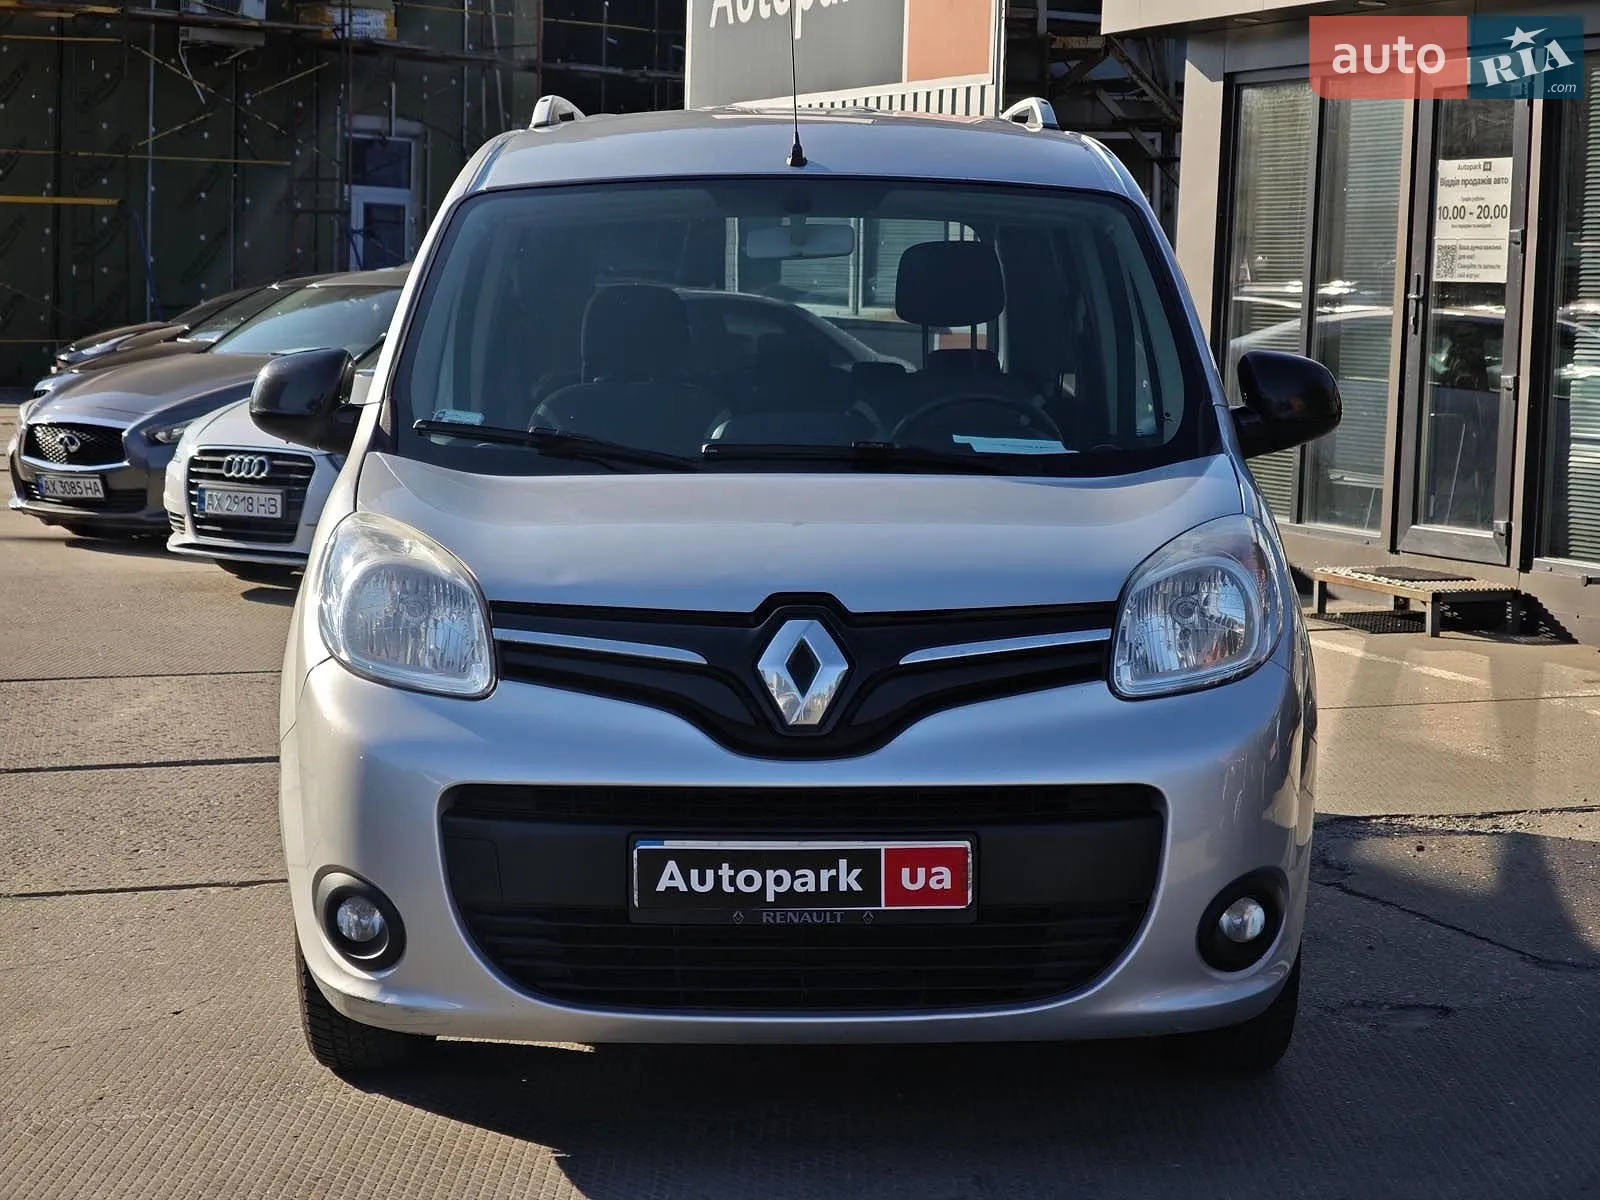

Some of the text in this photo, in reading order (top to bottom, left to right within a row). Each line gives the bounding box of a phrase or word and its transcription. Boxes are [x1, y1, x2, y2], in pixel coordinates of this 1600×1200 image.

[1457, 162, 1482, 172] Autopark
[1440, 175, 1509, 188] Відділ продажів авто
[1438, 205, 1466, 220] 10.00
[1476, 204, 1508, 219] 20.00
[44, 480, 102, 496] AX 3085 HA
[206, 493, 278, 515] AX 2918 HB
[655, 859, 952, 902] Autopark ua
[762, 911, 845, 924] RENAULT
